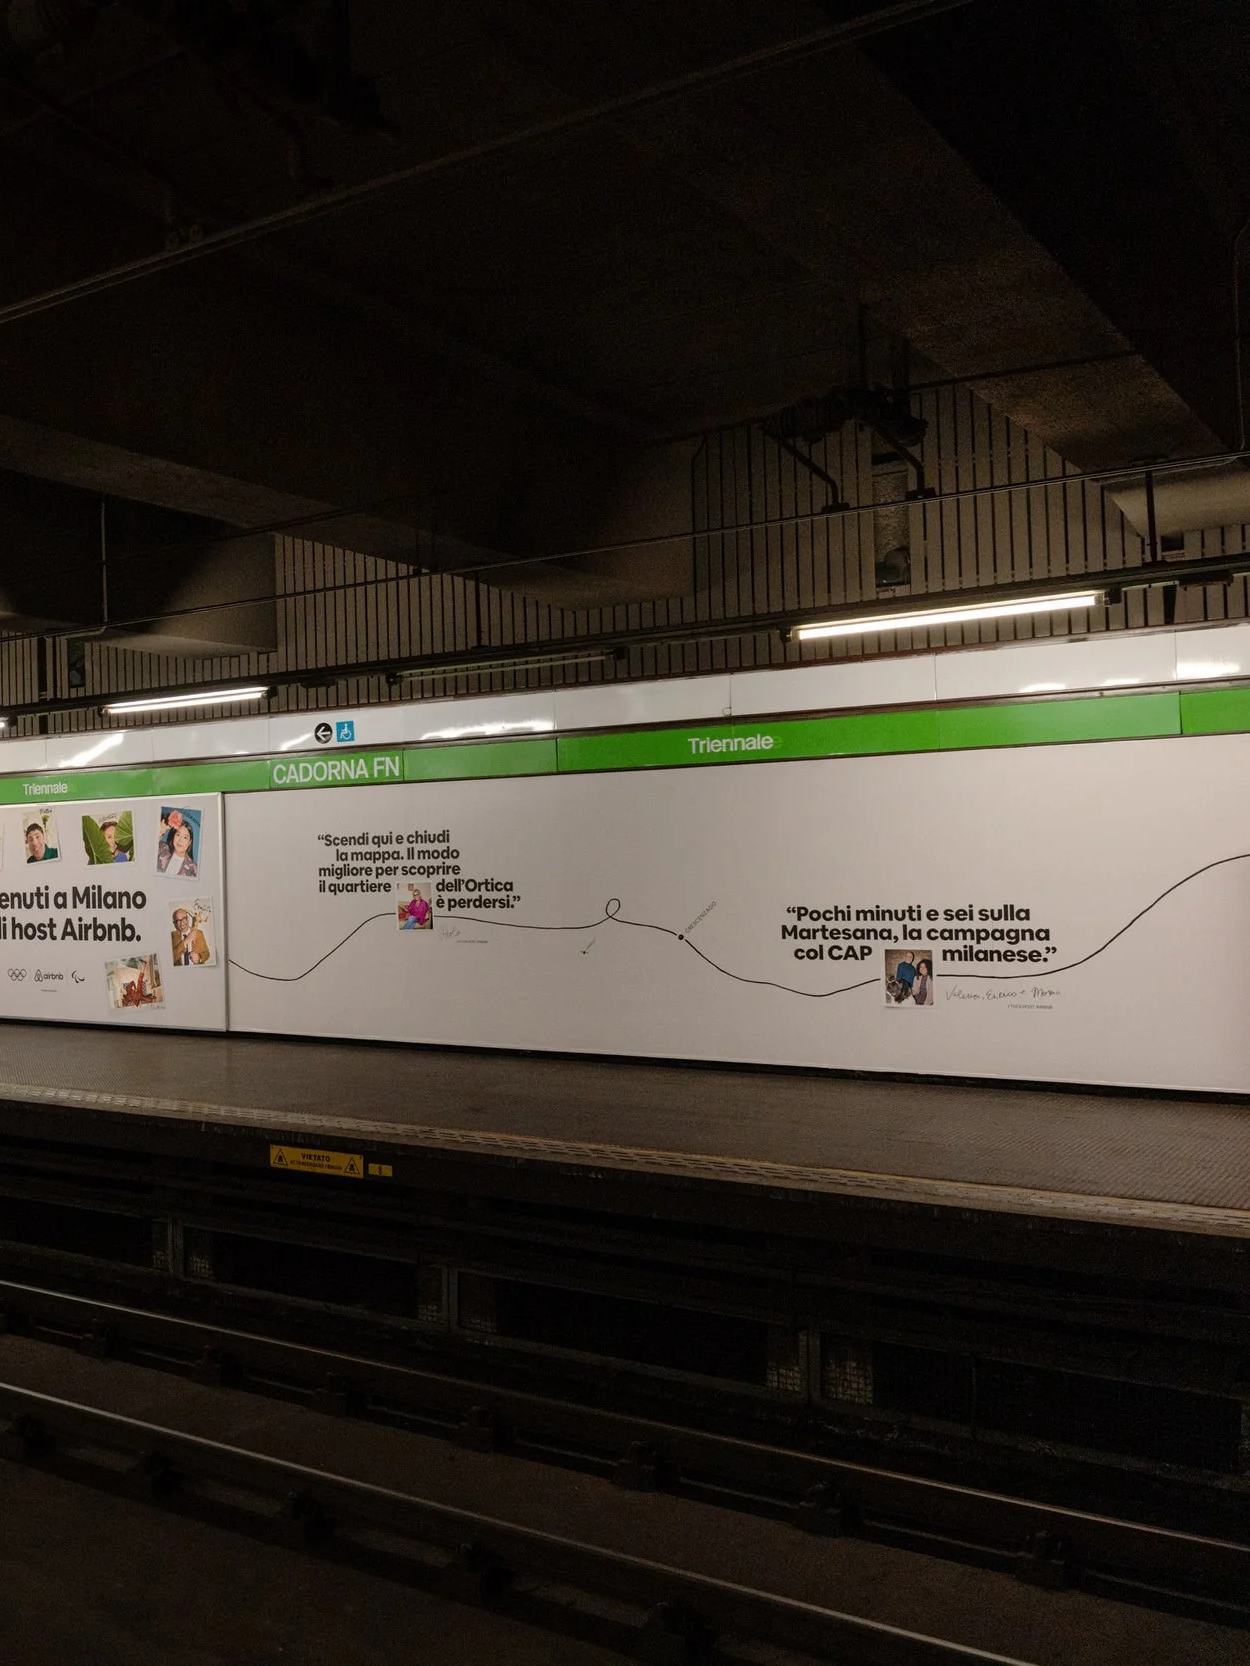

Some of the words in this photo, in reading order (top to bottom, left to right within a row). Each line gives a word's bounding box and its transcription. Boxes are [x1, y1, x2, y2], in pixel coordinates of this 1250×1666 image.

[688, 734, 774, 754] Triennale
[272, 757, 369, 784] CADORNA
[374, 756, 399, 777] FN
[22, 782, 69, 797] Triennale
[318, 832, 369, 846] “Scendi
[372, 832, 393, 848] qui
[395, 835, 404, 844] e
[407, 829, 449, 844] chiudi
[336, 849, 348, 861] la
[349, 851, 404, 865] mappa.
[407, 847, 414, 860] Il
[418, 846, 460, 860] modo
[319, 862, 374, 881] migliore
[374, 863, 399, 879] per
[401, 861, 461, 878] scoprire
[319, 880, 325, 892] il
[328, 879, 391, 895] quartiere
[436, 878, 513, 892] dell’Ortica
[54, 892, 67, 909] a
[72, 885, 146, 909] Milano
[436, 895, 445, 908] è
[448, 895, 520, 911] perdersi.”
[684, 901, 717, 934] CRESCENZAGO
[787, 905, 851, 921] “Pochi
[856, 905, 921, 921] minuti
[926, 909, 939, 921] e
[943, 904, 973, 921] sei
[978, 904, 1030, 921] sulla
[12, 917, 57, 940] host
[61, 917, 141, 942] Airbnb.
[782, 925, 899, 946] Martesana,
[903, 924, 922, 940] la
[926, 928, 1050, 947] campagna
[794, 944, 823, 960] col
[828, 945, 872, 960] CAP
[942, 944, 1057, 962] milanese.”
[43, 972, 64, 980] airbnb
[301, 1152, 331, 1162] VIETATO
